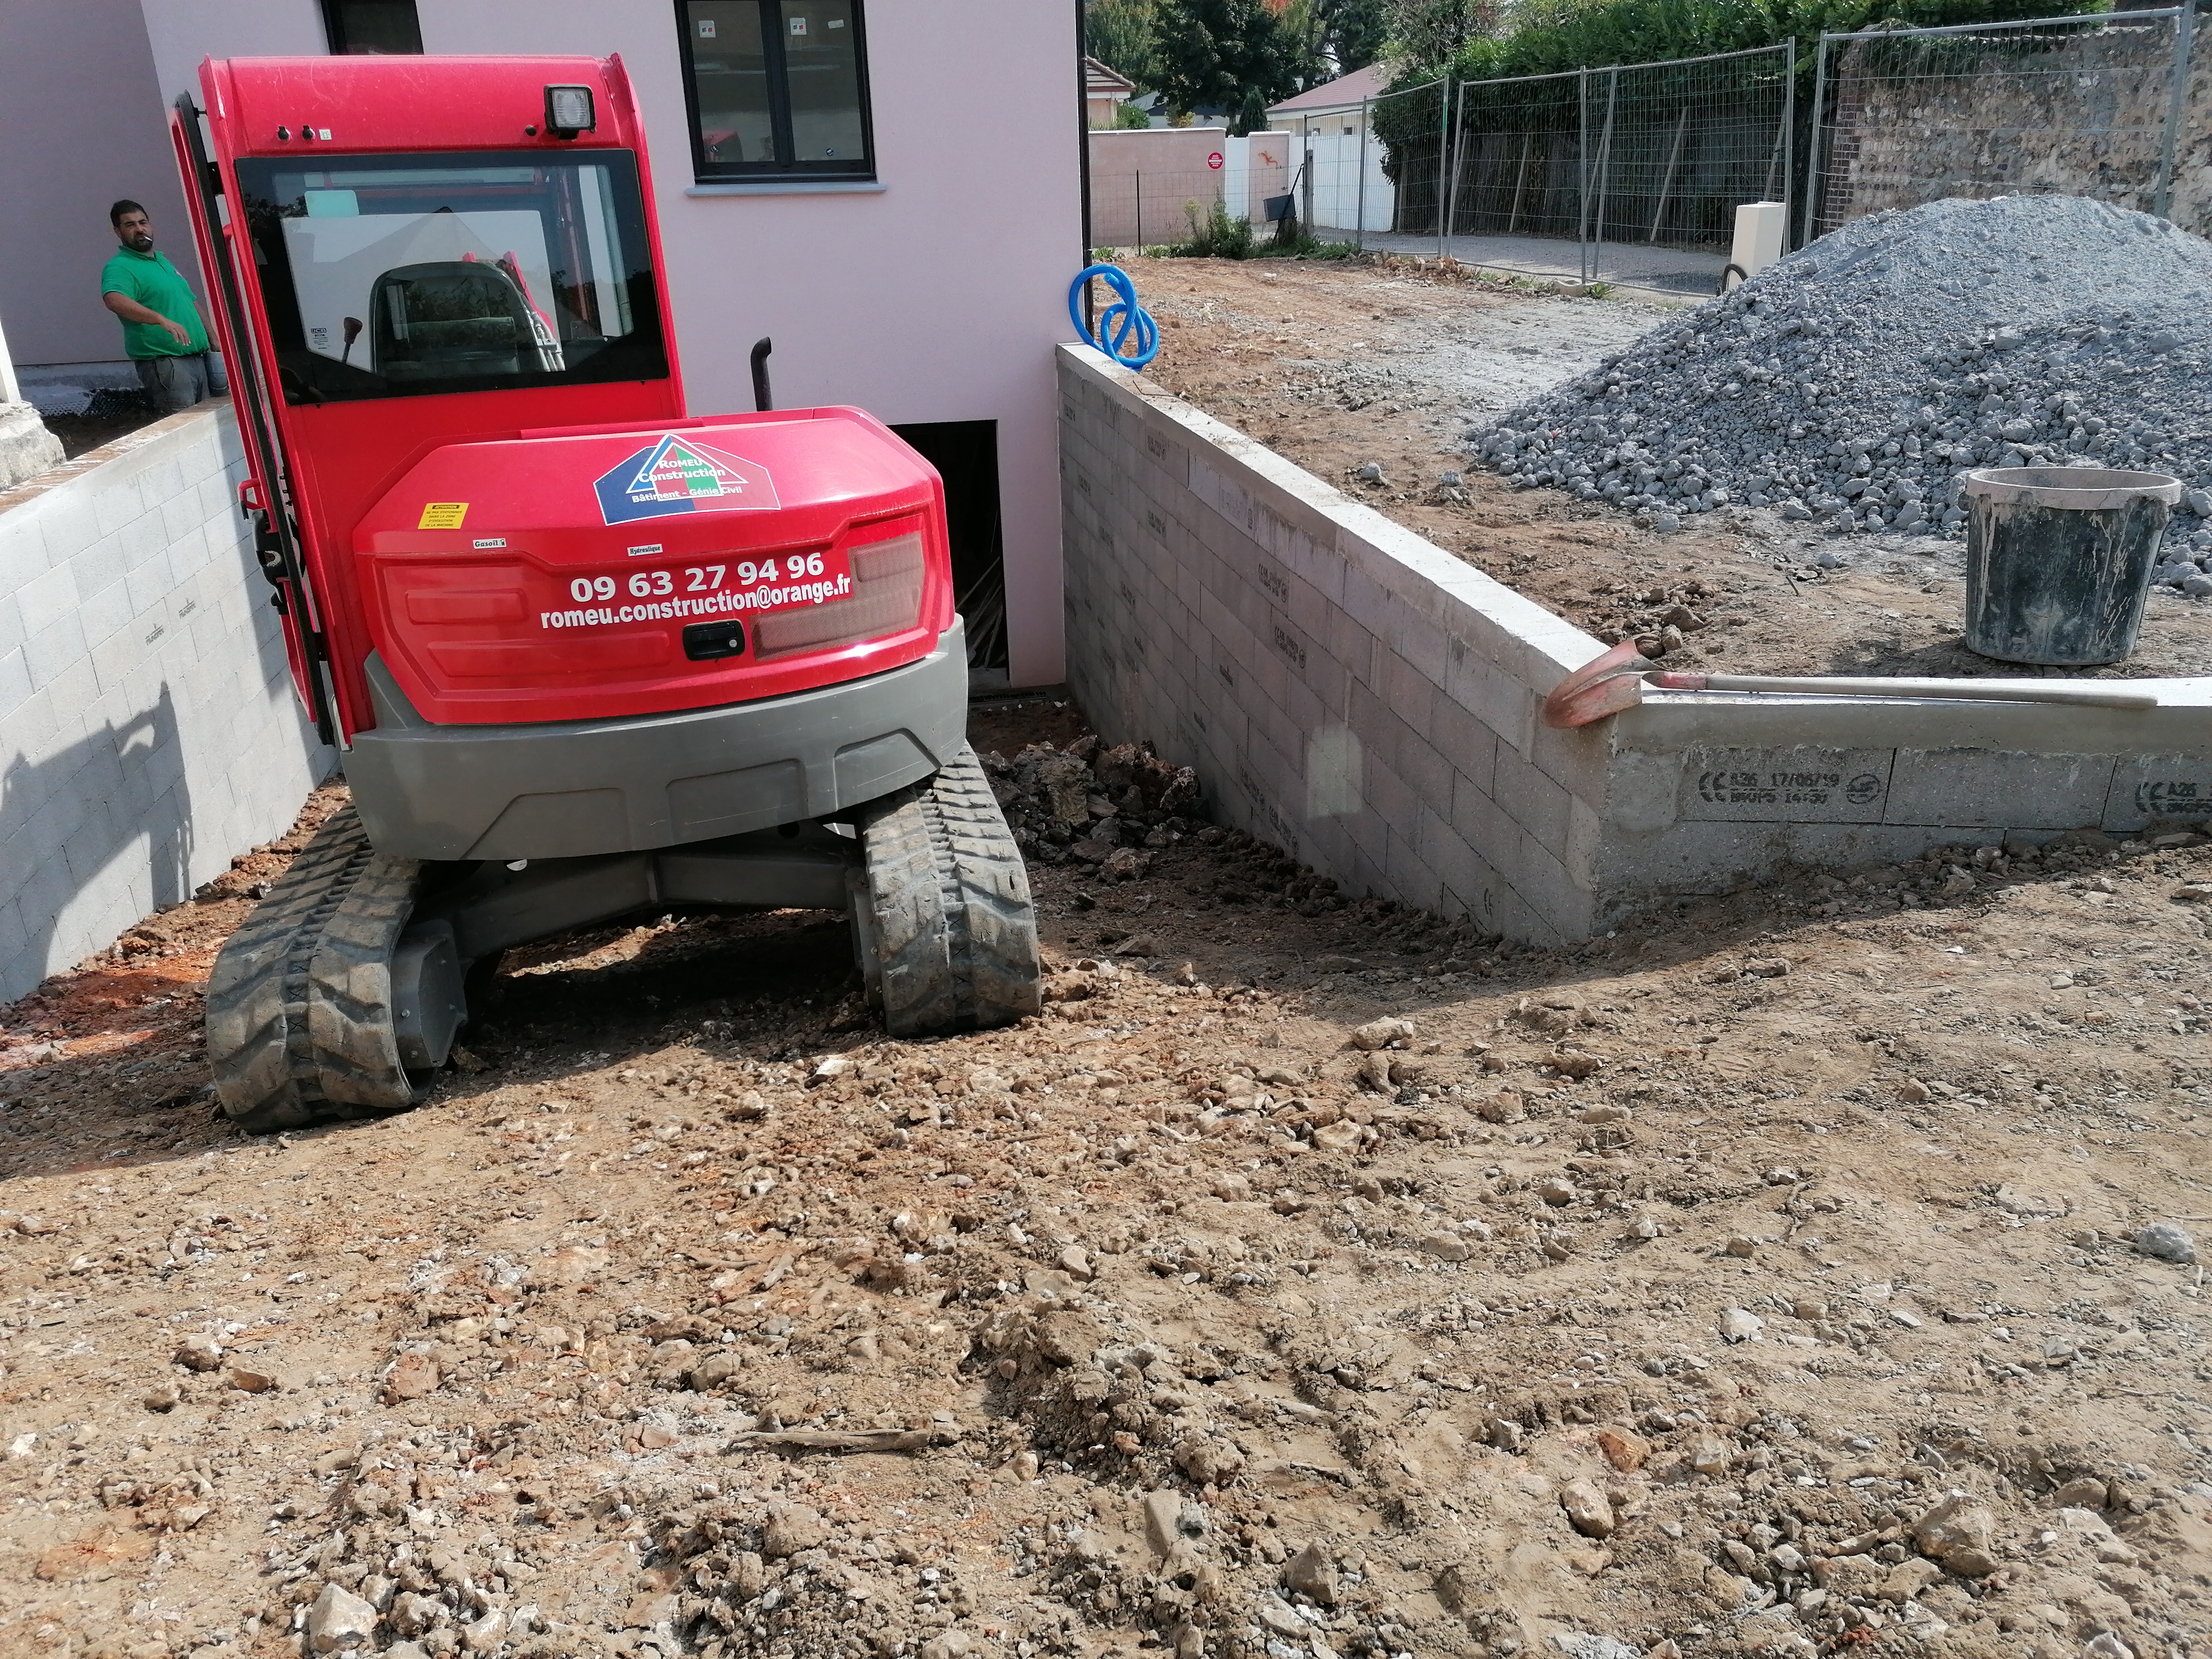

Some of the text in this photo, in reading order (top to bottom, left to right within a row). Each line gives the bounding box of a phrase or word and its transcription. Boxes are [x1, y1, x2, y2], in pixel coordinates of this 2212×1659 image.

[659, 458, 703, 469] ROMEU
[639, 468, 726, 483] Construction
[632, 490, 681, 503] Bâtiment
[689, 487, 719, 496] Génie
[721, 486, 743, 494] Civil
[630, 546, 660, 555] Hydraulique
[570, 552, 825, 602] 09 63 27 94 96
[541, 573, 851, 629] romeu.construction@orange.fr
